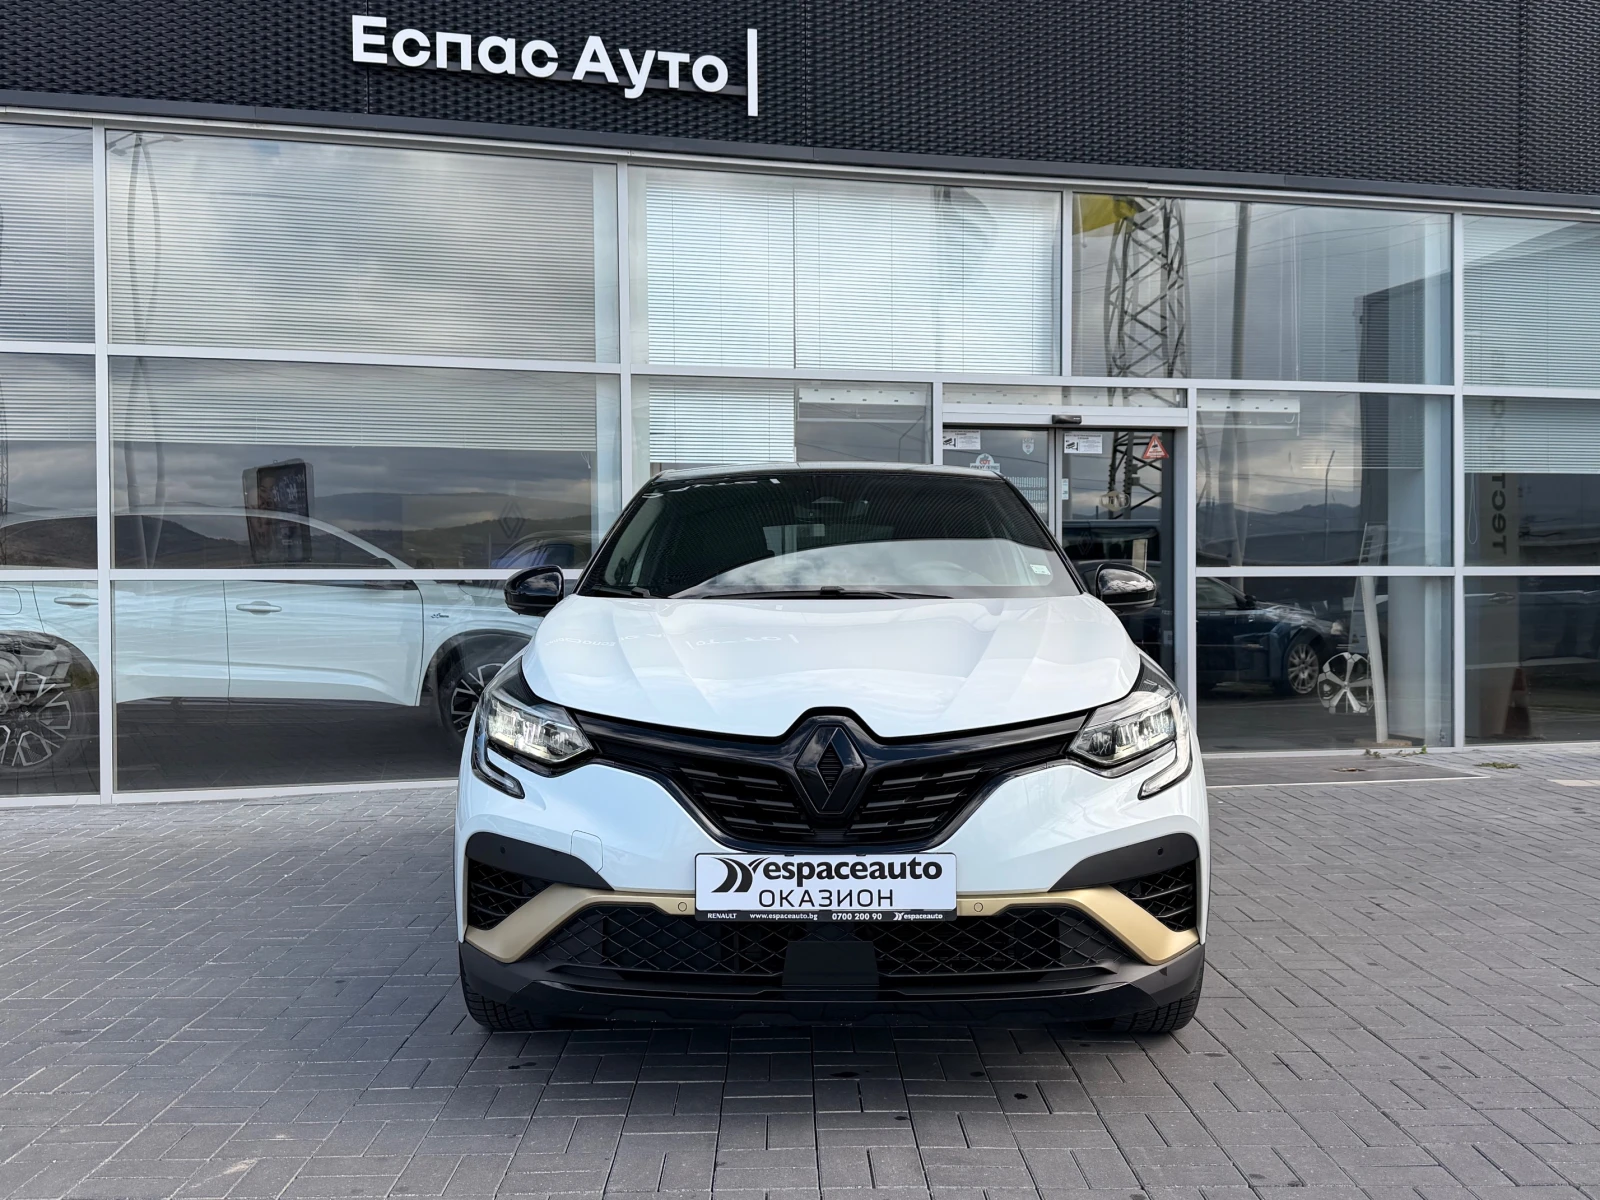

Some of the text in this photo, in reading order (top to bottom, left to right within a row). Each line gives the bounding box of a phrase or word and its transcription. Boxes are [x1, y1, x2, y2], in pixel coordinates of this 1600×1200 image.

[352, 14, 729, 99] Еспас Ауто
[762, 857, 943, 887] espaceauto
[758, 888, 893, 908] ОКАЗИОН
[749, 912, 819, 921] www.espaceauto.bg
[831, 912, 883, 921] 0700 200 90
[903, 912, 943, 921] espaceauto
